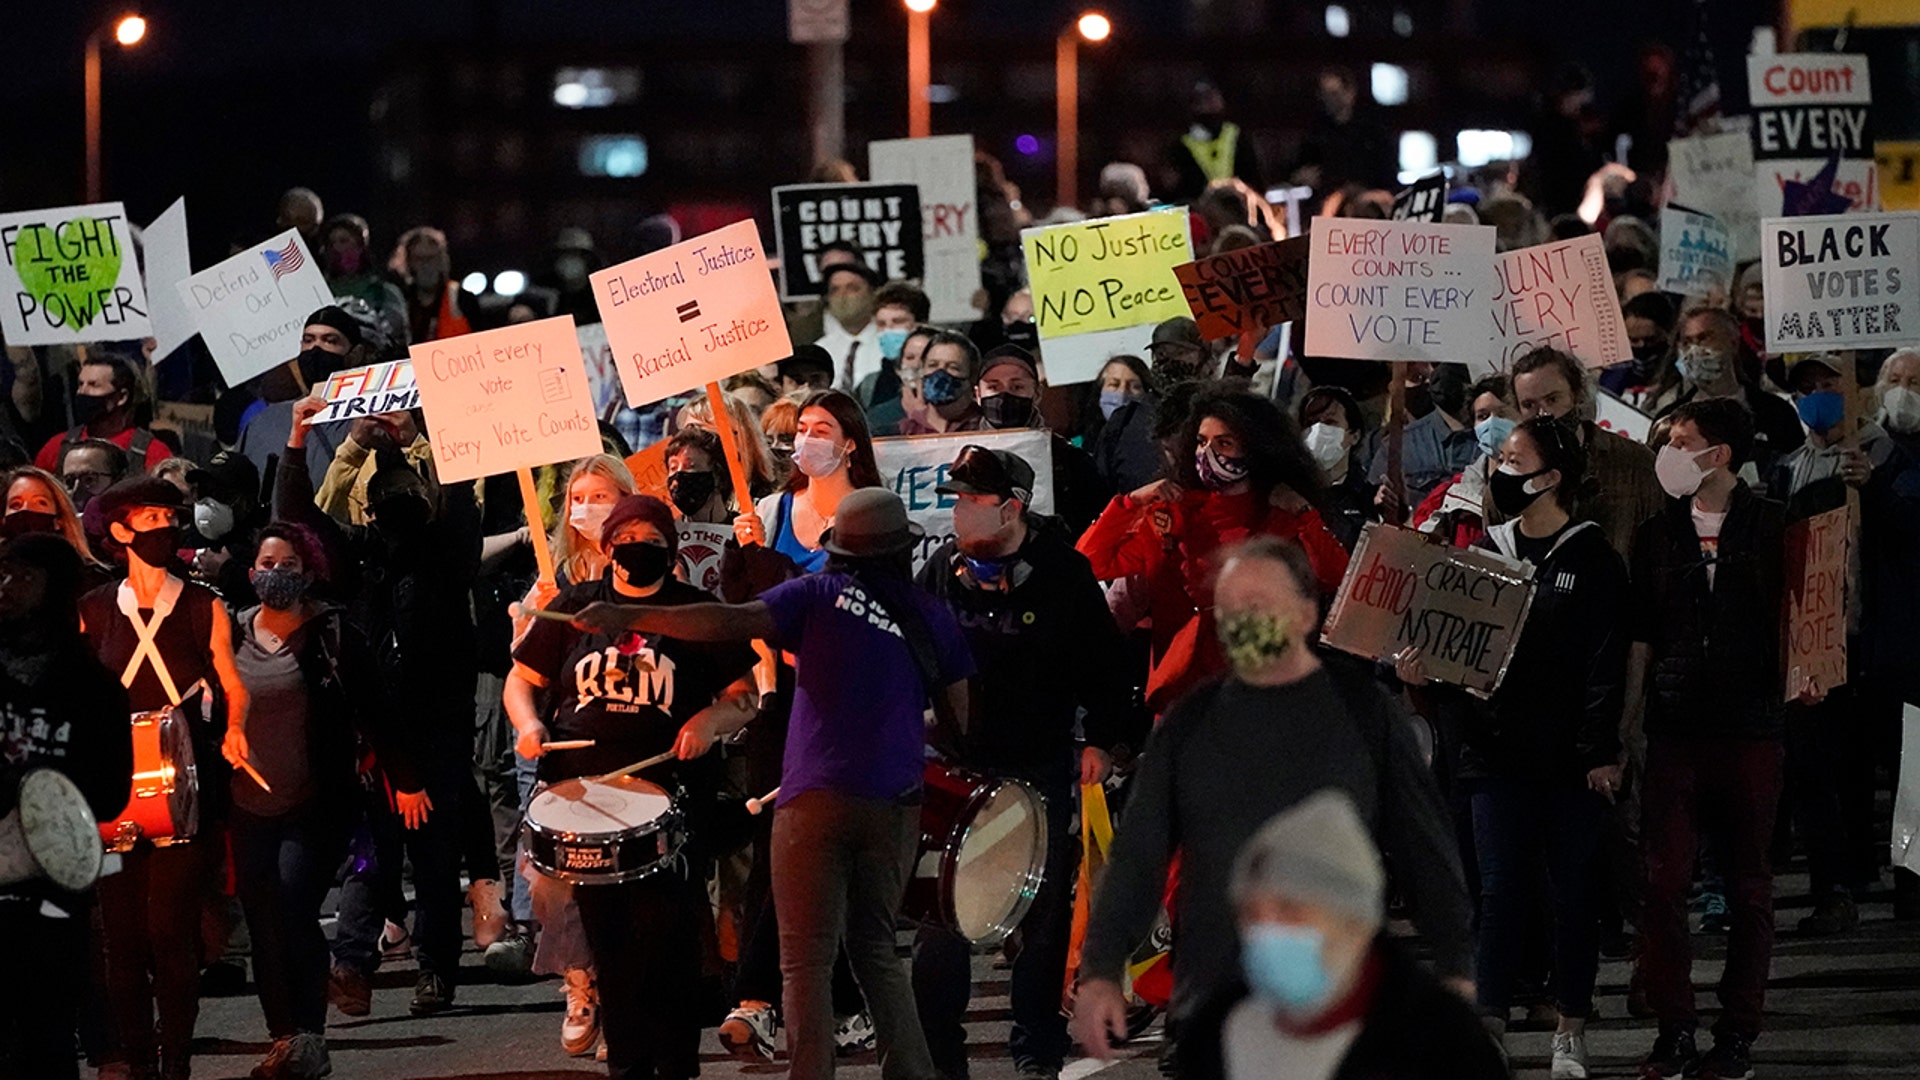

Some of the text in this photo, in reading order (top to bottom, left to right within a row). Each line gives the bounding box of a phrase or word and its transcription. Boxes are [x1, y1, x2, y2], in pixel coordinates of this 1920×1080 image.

[1759, 108, 1867, 151] EVERY
[799, 197, 902, 222] COUNT
[1, 215, 121, 266] FIGHT
[800, 220, 903, 250] EVERY
[1035, 224, 1186, 267] NO Justice
[1328, 229, 1452, 256] EVERY VOTE
[1777, 223, 1891, 268] BLACK
[45, 265, 90, 283] THE
[607, 245, 756, 307] Electoral Justice
[1196, 245, 1280, 281] COUNT
[1806, 267, 1901, 300] VOTES
[190, 266, 260, 309] Defend
[245, 291, 273, 313] Our
[1040, 278, 1175, 327] NO Peace
[1315, 282, 1474, 310] COUNT EVERY
[17, 286, 147, 332] POWER
[1349, 313, 1441, 345] VOTE
[1777, 302, 1902, 341] MATTER
[431, 341, 543, 382] Count every
[632, 337, 693, 379] Racial
[700, 318, 770, 353] Justice
[479, 376, 513, 396] vote
[437, 409, 591, 464] Every Vote Counts
[694, 530, 724, 545] THE
[1351, 552, 1509, 615] demo CRACY
[834, 594, 906, 640] NO PEA
[1397, 609, 1504, 674] NSTRATE
